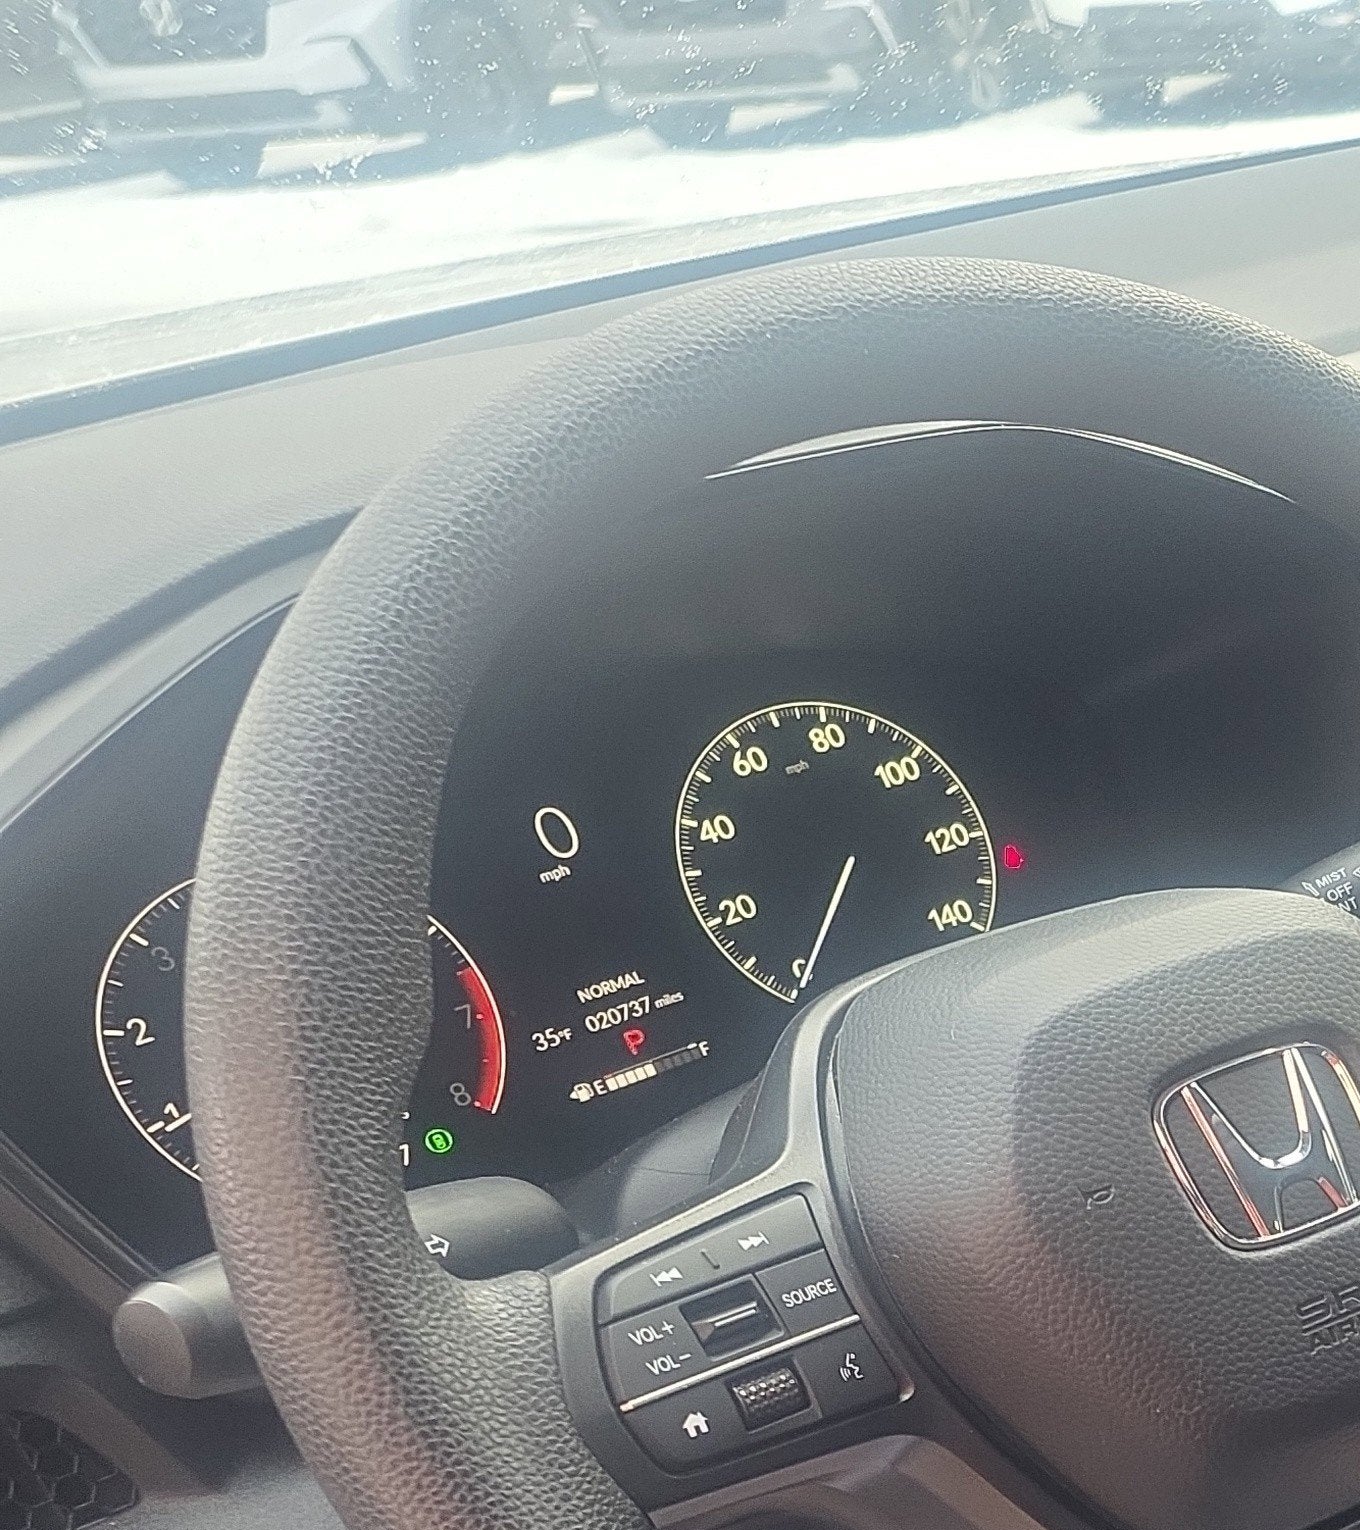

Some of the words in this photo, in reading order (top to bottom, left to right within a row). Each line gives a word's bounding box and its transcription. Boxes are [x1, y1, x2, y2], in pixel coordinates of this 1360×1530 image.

[808, 723, 846, 753] 80
[732, 746, 768, 777] 60
[874, 756, 921, 789] 100
[535, 806, 579, 859] 0
[700, 815, 736, 844] 40
[924, 823, 970, 855] 120
[539, 864, 571, 883] mph
[1315, 866, 1347, 889] MIST
[1326, 882, 1354, 901] OFF
[1337, 896, 1358, 911] NT
[718, 894, 757, 926] 20
[928, 899, 973, 931] 140
[151, 946, 175, 972] 3
[576, 971, 645, 1003] NORMAL
[454, 1003, 472, 1029] 7
[584, 996, 650, 1033] 020737
[654, 990, 684, 1009] miles
[126, 1018, 155, 1046] 2
[623, 1028, 645, 1056] P
[699, 1040, 710, 1057] F
[450, 1081, 472, 1106] 8
[593, 1078, 606, 1097] E
[782, 1278, 837, 1308] SOURCE
